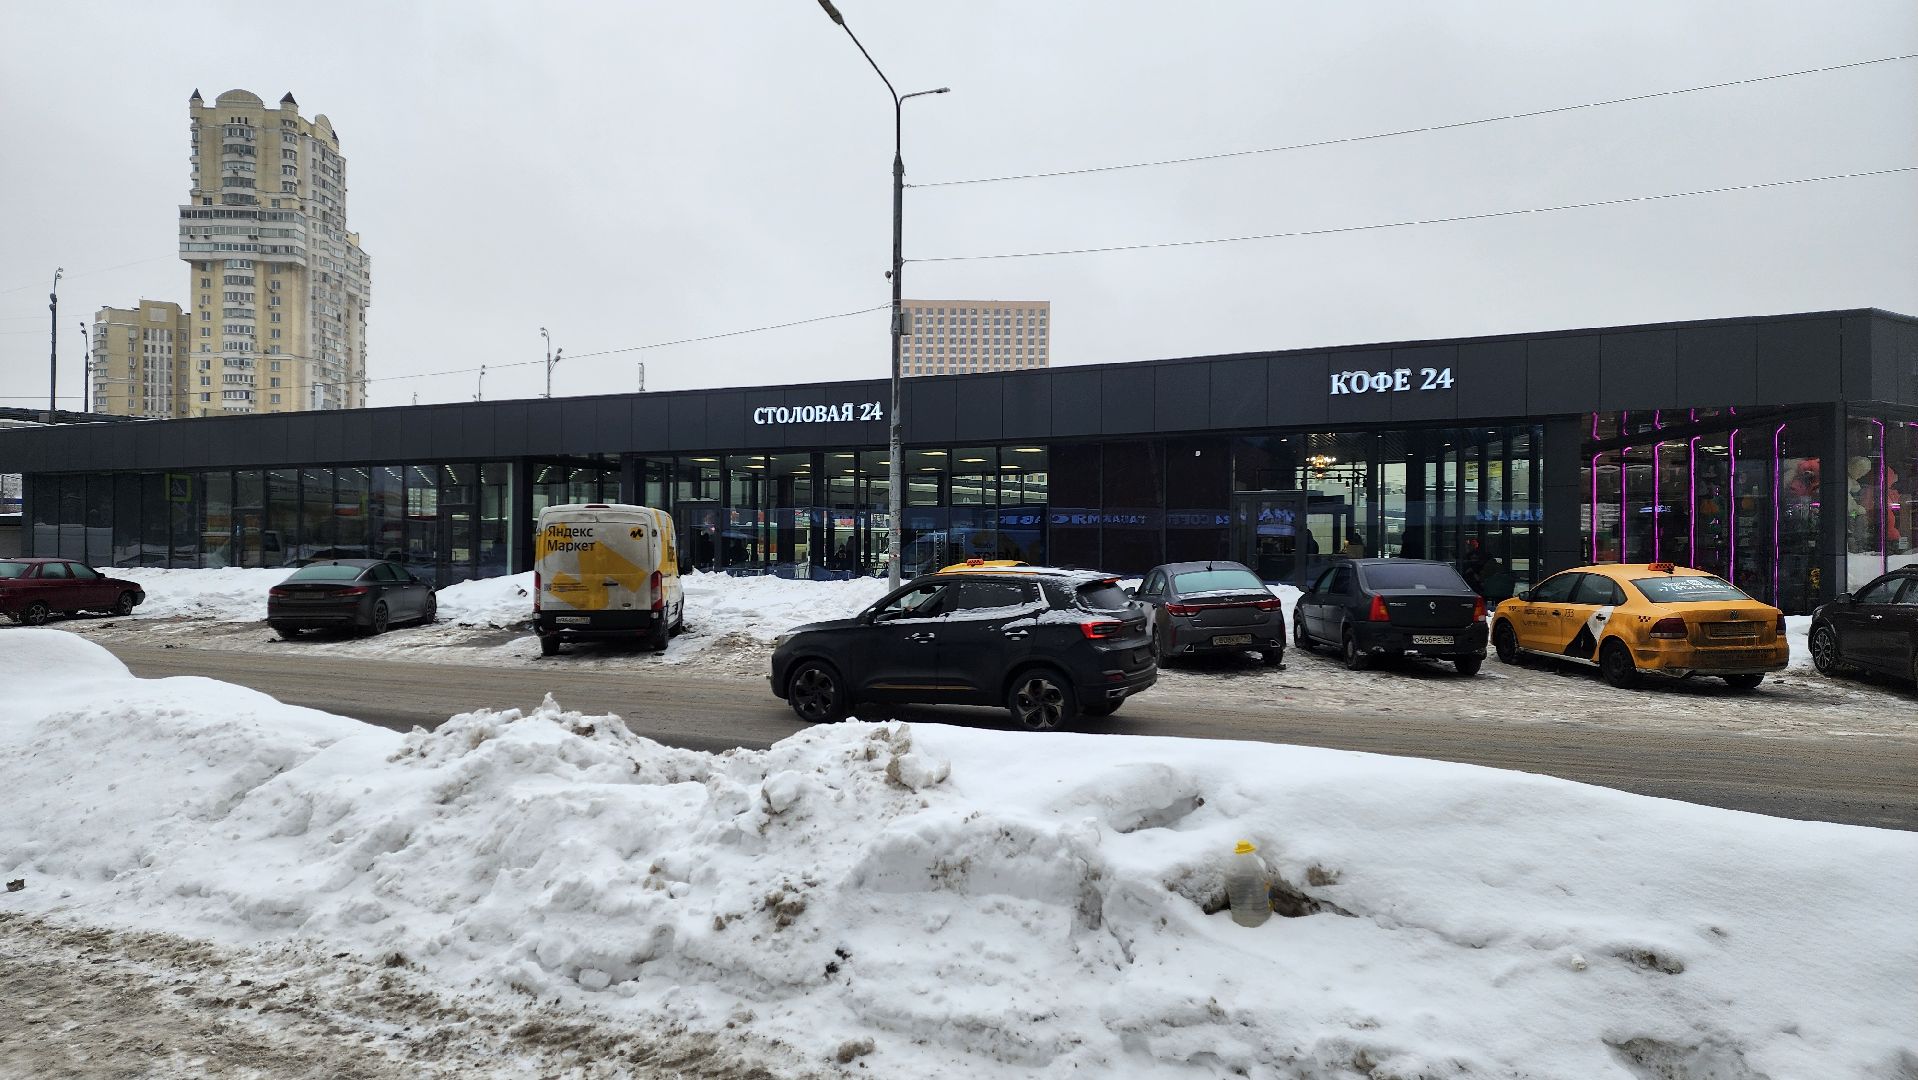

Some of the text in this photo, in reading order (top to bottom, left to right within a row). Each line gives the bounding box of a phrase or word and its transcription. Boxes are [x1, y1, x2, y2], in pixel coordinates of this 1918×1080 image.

[1330, 367, 1454, 395] КОФЕ 24
[753, 401, 883, 425] СТОЛОВАЯ 24
[548, 525, 594, 539] Яндекс
[547, 539, 596, 552] Маркет
